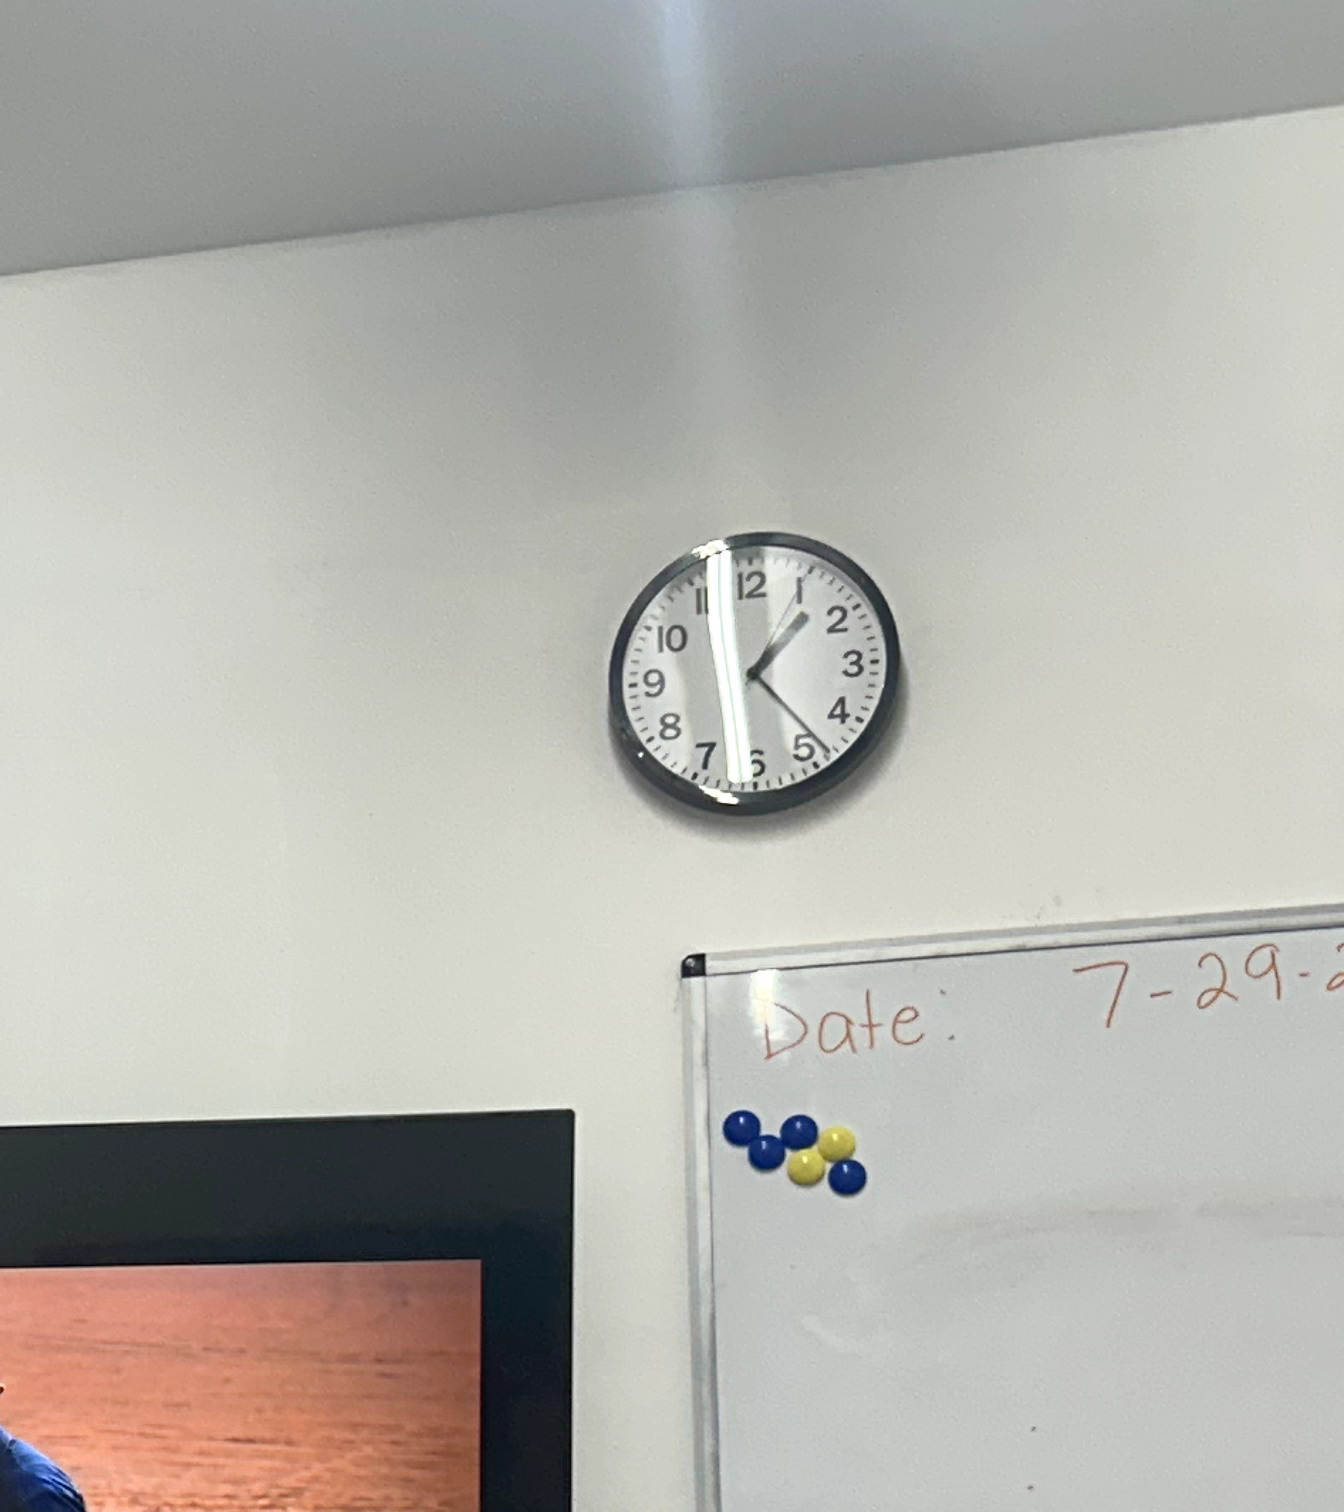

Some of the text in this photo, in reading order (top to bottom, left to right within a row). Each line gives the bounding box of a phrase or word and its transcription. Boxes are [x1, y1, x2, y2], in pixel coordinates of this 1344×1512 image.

[737, 570, 767, 601] 12
[795, 576, 804, 605] 1
[826, 605, 849, 634] 2
[657, 624, 688, 653] 10
[841, 649, 865, 678] 3
[642, 668, 666, 698] 9
[827, 696, 850, 725] 4
[658, 712, 682, 741] 8
[695, 742, 717, 770] 7
[792, 733, 815, 762] 5
[764, 989, 956, 1060] Date:
